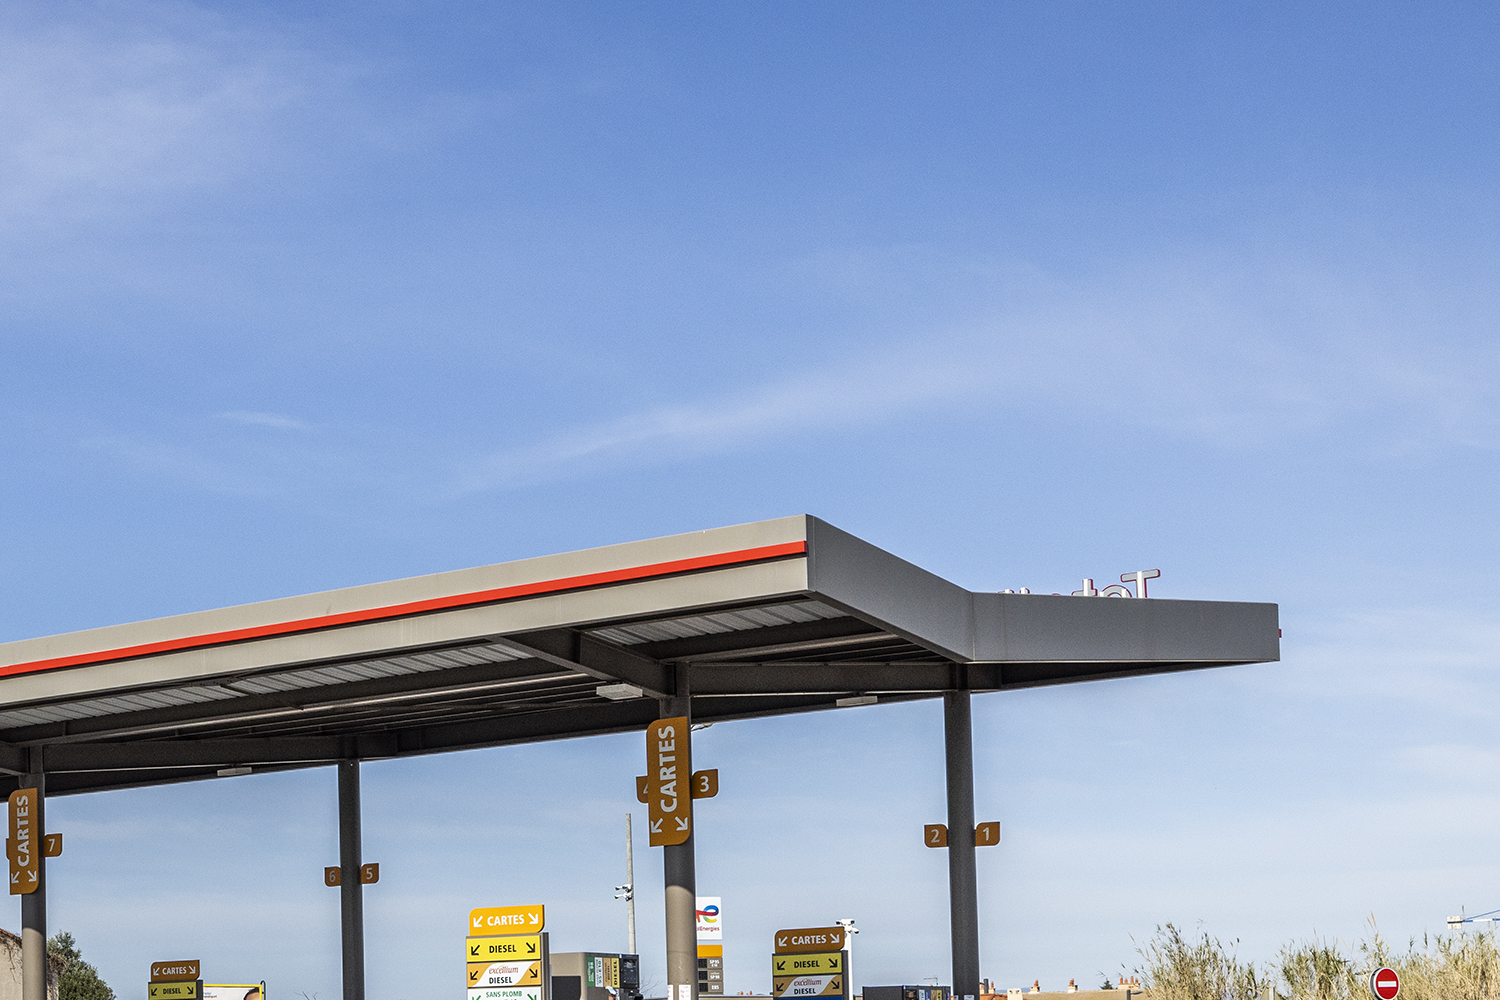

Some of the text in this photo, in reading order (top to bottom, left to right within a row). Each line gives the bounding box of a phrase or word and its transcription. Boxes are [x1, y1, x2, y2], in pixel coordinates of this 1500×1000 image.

[658, 725, 677, 812] CARTES
[700, 776, 709, 792] 3
[17, 795, 30, 866] CARTES
[930, 828, 940, 843] 2
[982, 826, 990, 841] 1
[48, 838, 56, 852] 7
[329, 870, 336, 882] 6
[366, 868, 373, 880] 5
[487, 914, 525, 926] CARTES
[791, 935, 827, 945] CARTES
[489, 945, 517, 953] DIESEL
[162, 967, 187, 975] CARTES
[489, 965, 518, 975] excellium
[794, 978, 822, 986] excellium
